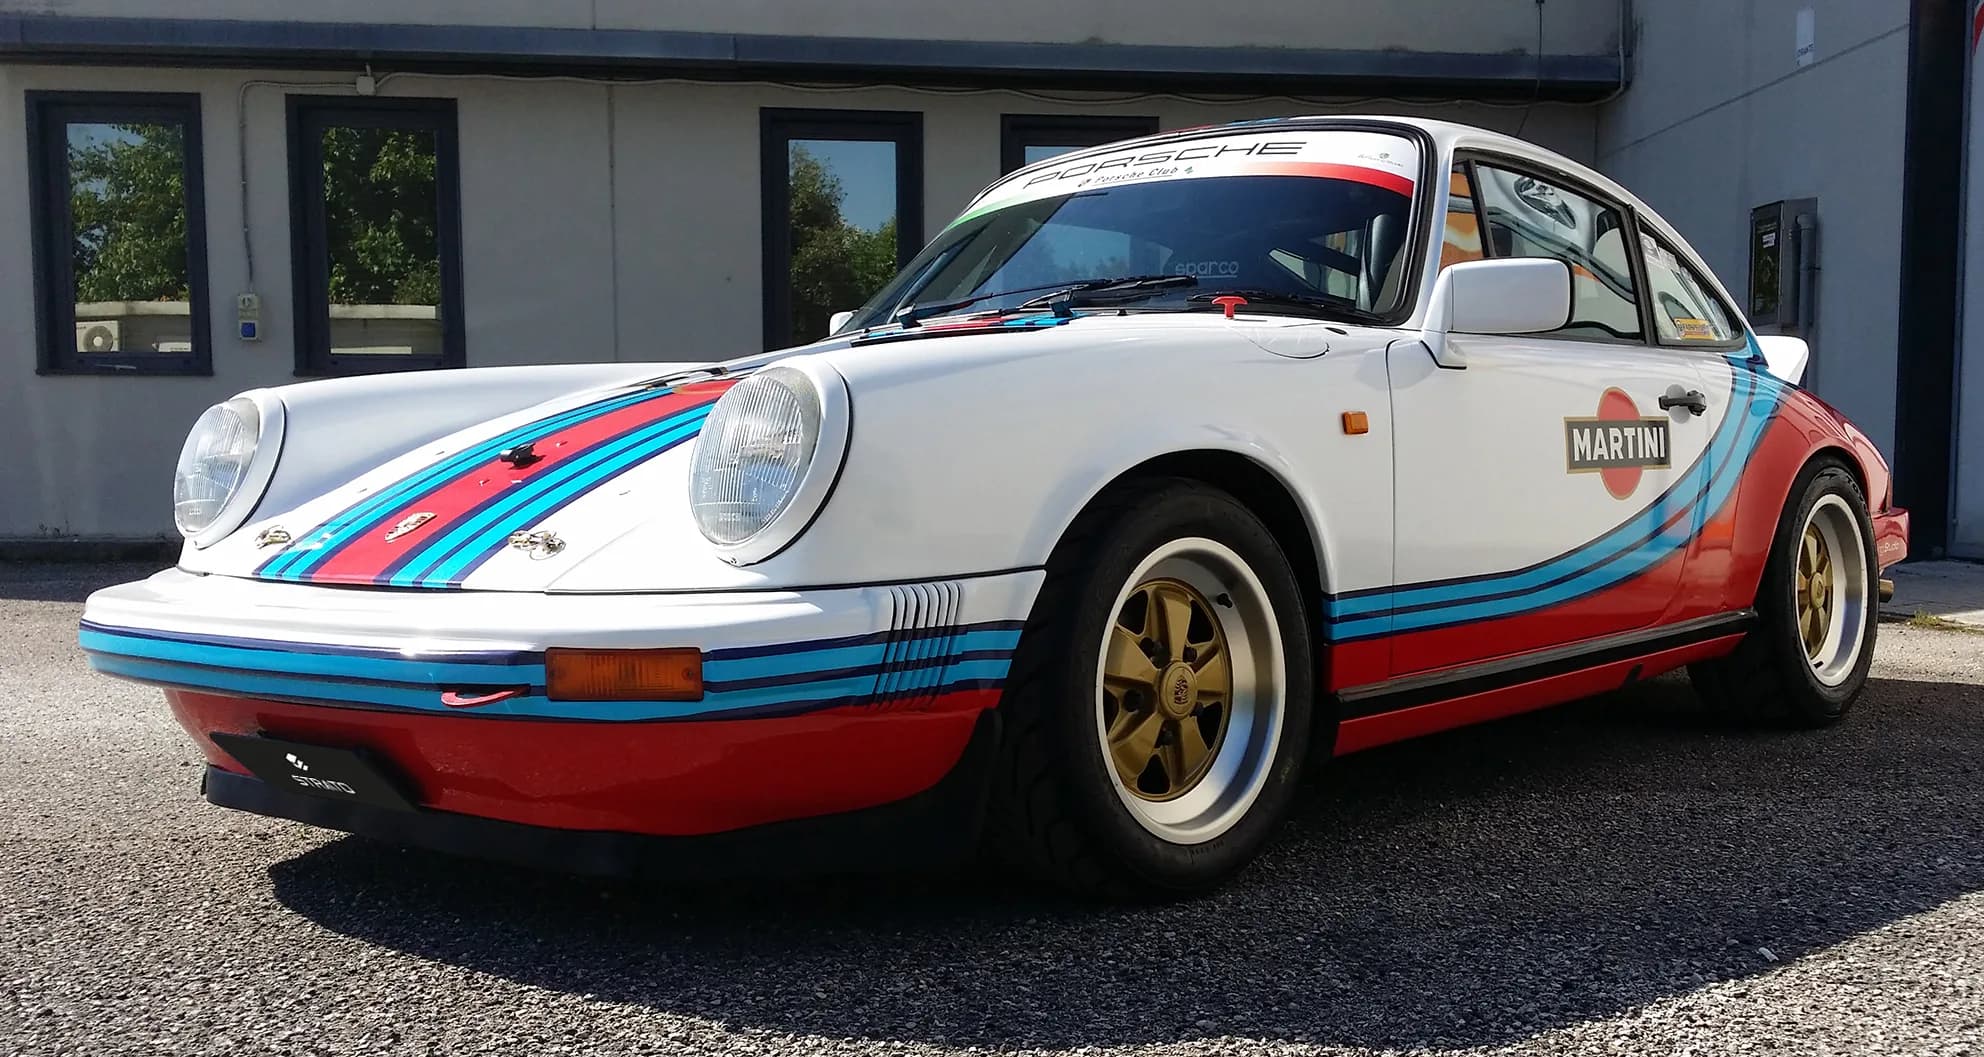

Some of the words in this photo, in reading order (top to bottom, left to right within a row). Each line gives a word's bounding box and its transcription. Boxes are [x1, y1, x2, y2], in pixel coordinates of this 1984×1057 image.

[1023, 141, 1307, 189] PORSCHE
[1095, 171, 1144, 183] Porsche
[1148, 166, 1179, 178] Club
[1175, 260, 1239, 276] sparco
[1572, 426, 1665, 462] MARTINI
[291, 774, 356, 795] STRATO
